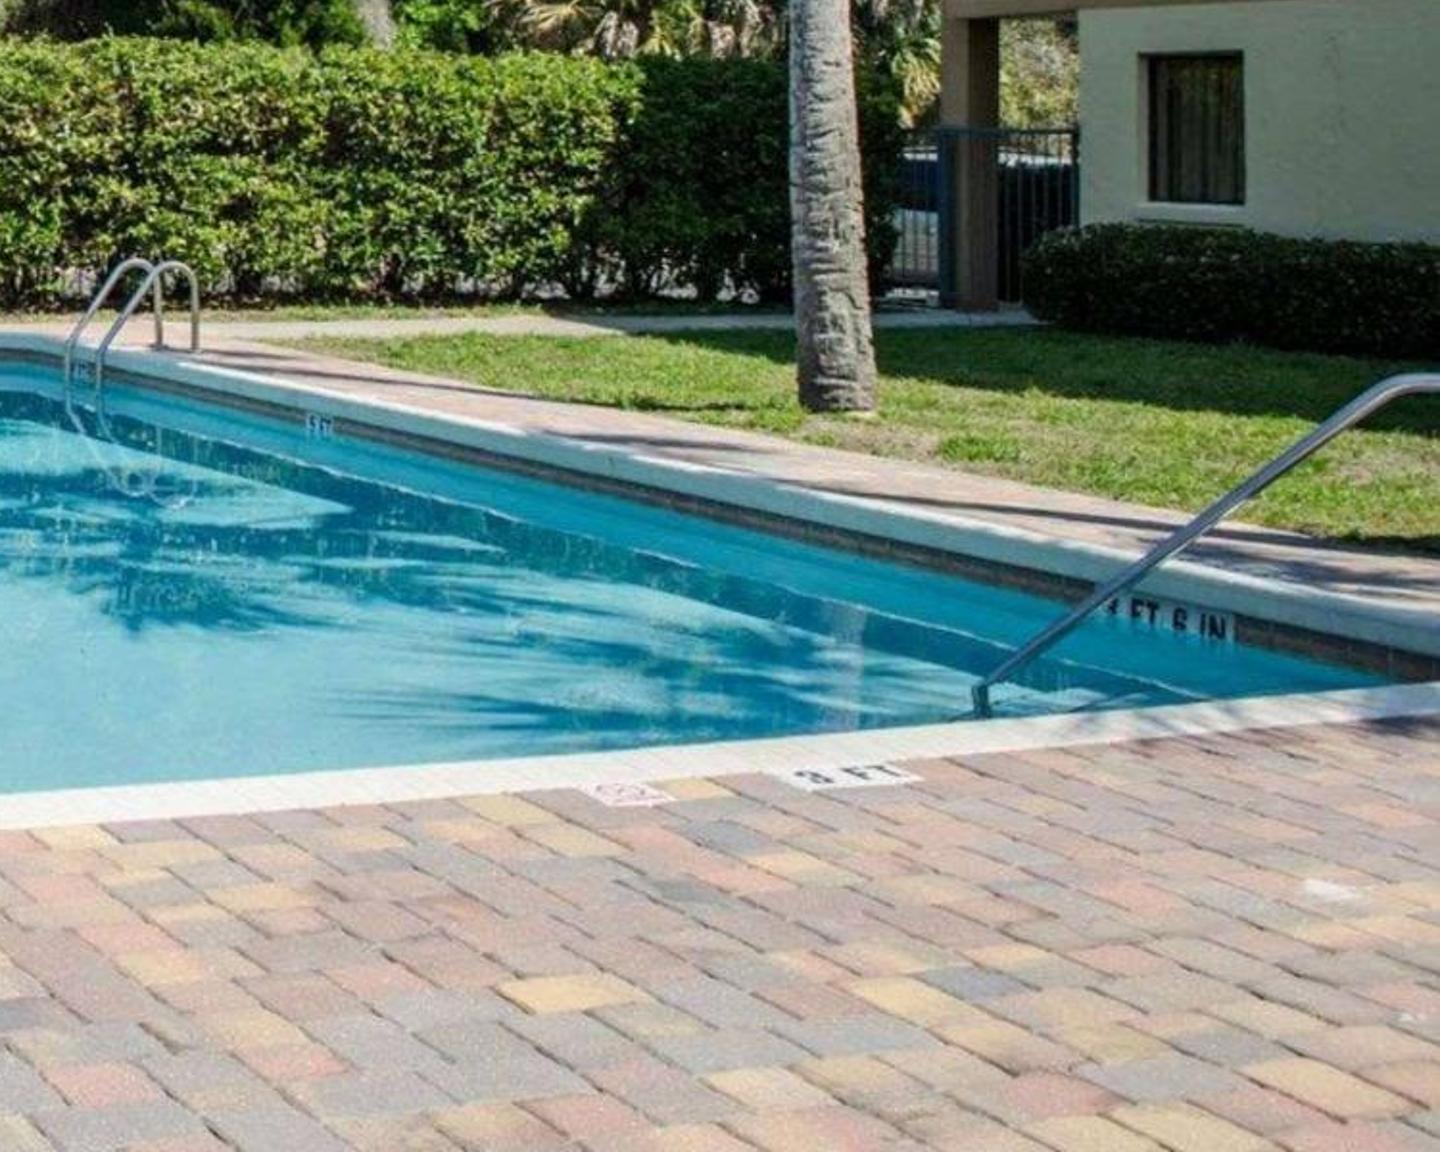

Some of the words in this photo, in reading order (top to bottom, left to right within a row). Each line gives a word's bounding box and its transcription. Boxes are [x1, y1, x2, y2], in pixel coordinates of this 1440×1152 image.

[1131, 597, 1160, 624] FT
[1199, 612, 1226, 639] IN
[794, 770, 833, 785] 3
[841, 762, 901, 781] FT
